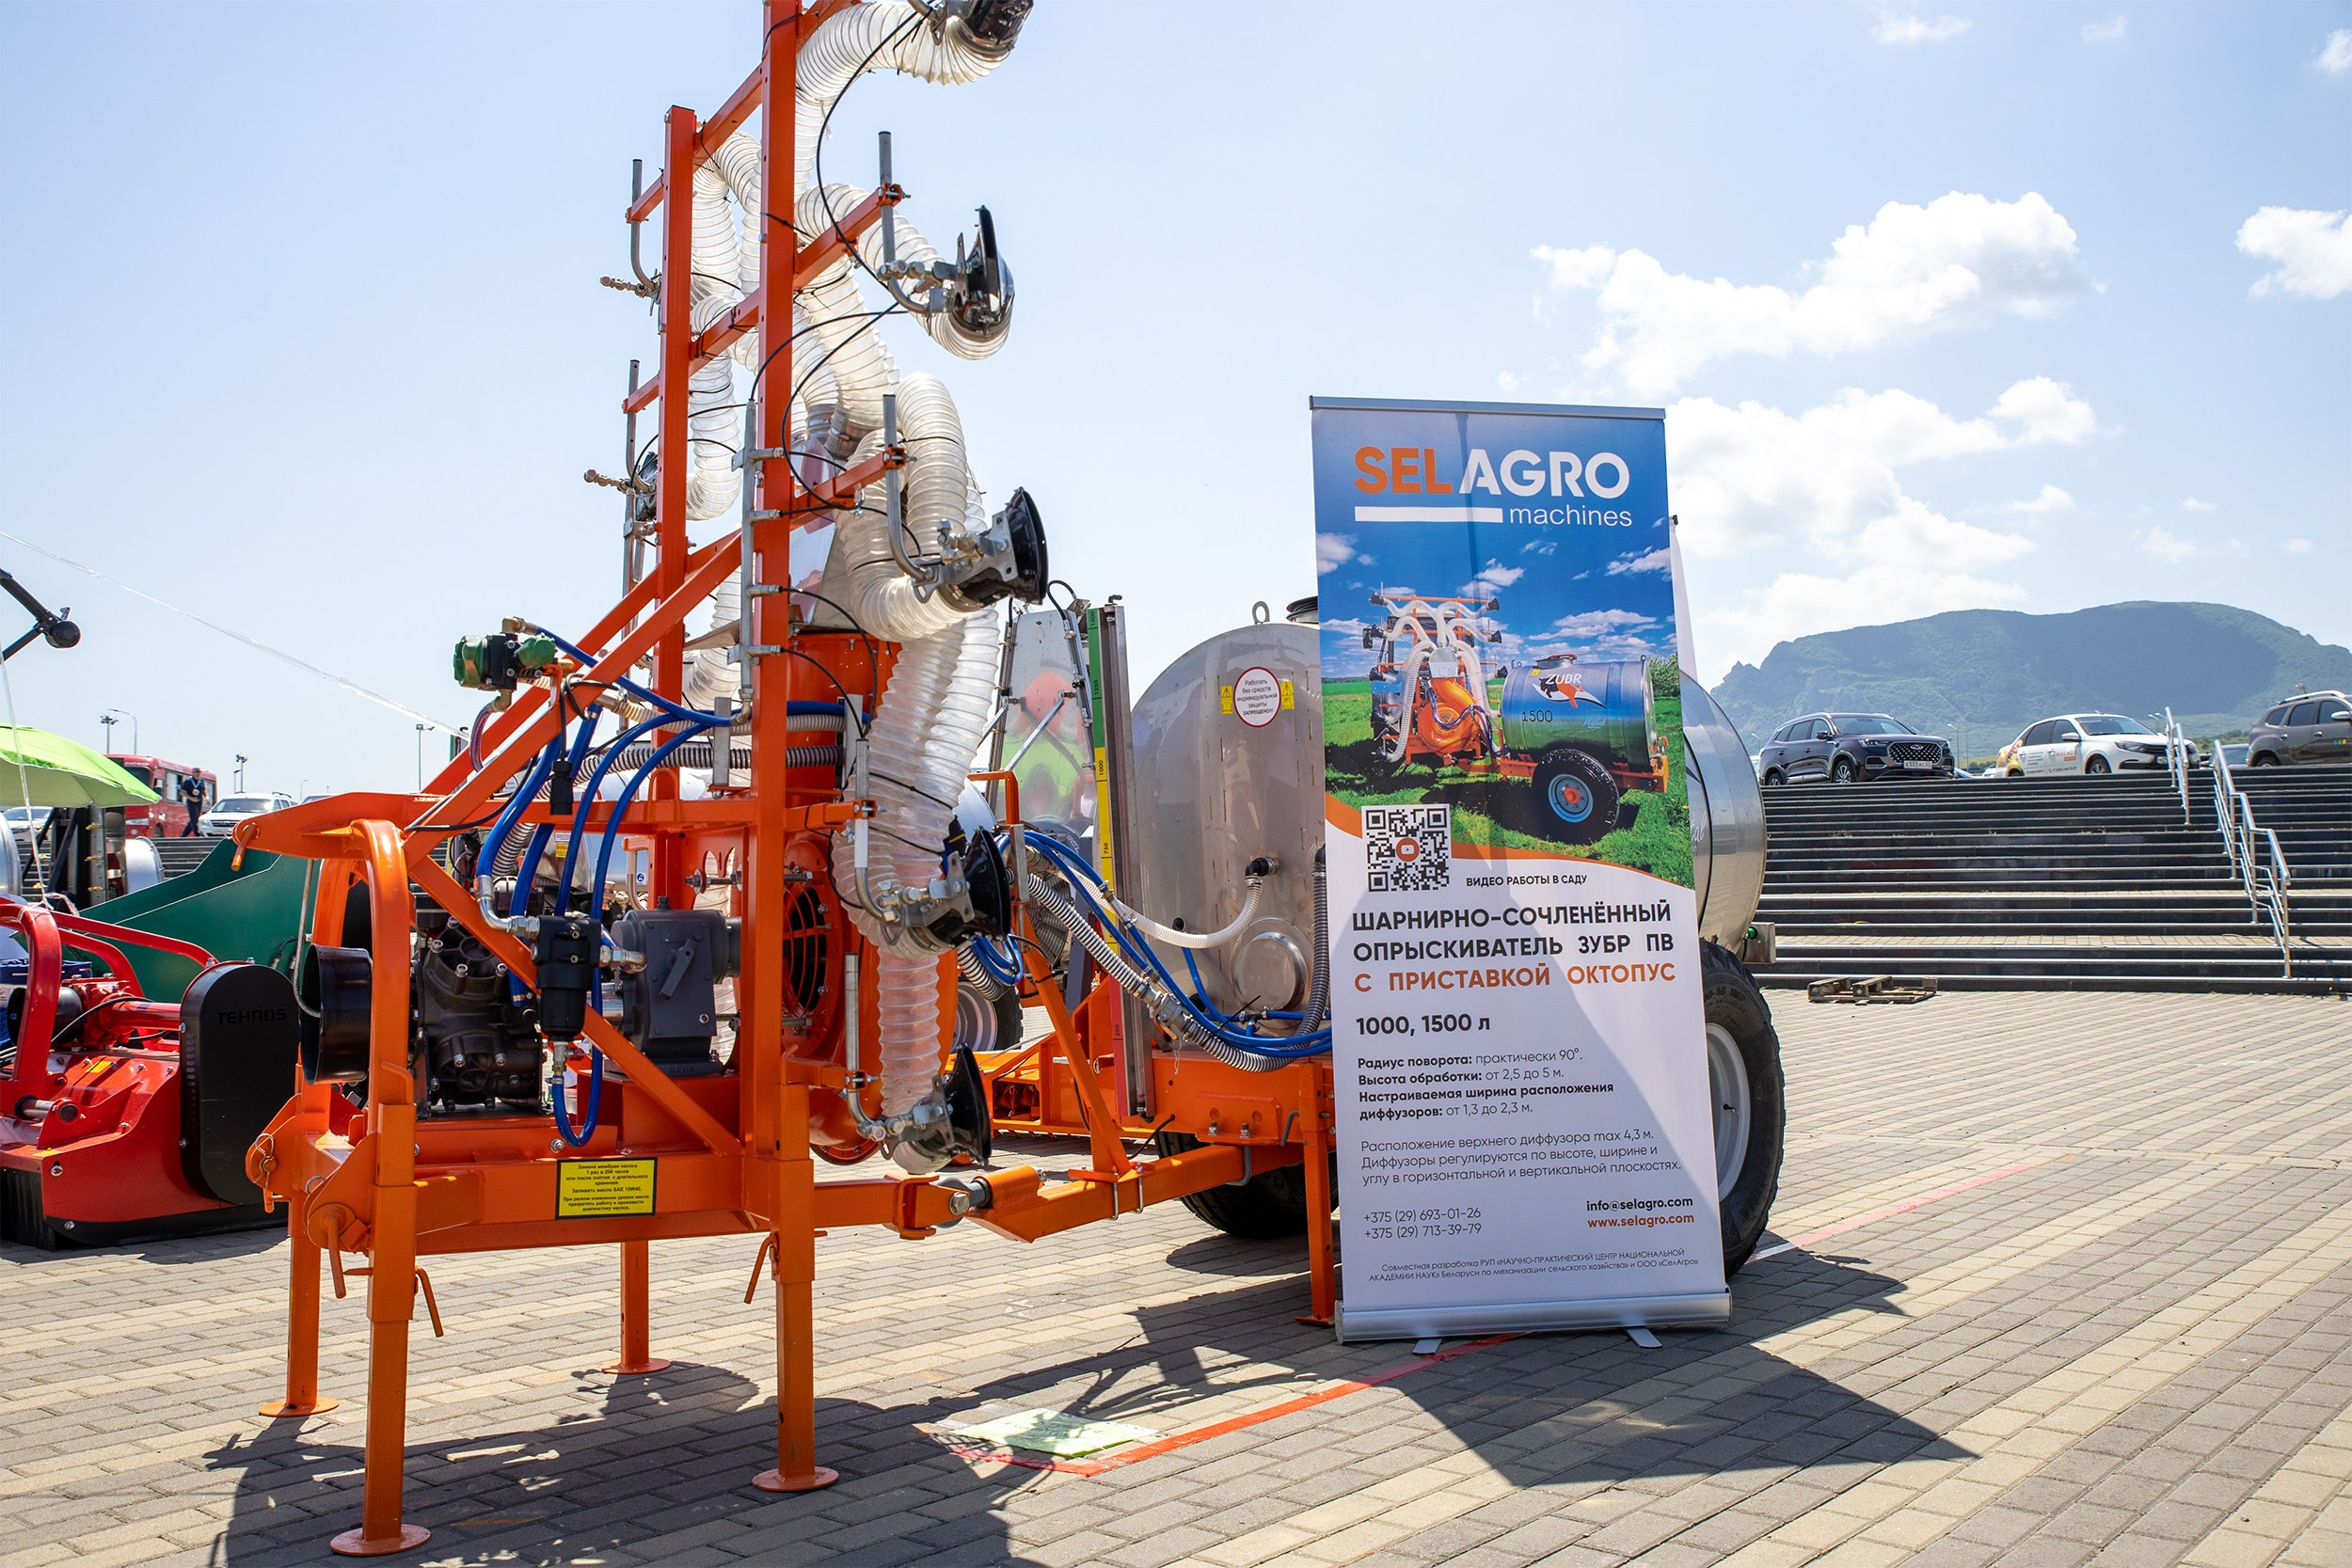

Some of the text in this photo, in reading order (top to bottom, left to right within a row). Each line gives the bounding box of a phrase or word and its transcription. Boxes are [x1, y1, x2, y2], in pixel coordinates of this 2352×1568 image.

[1509, 504, 1632, 527] machines
[1545, 673, 1582, 686] ZUBR
[1521, 709, 1553, 722] 1500
[1466, 875, 1588, 887] ВИДЕО РАБОТЫ В САДУ
[1352, 899, 1672, 931] ШАРНИРНО-СОЧЛЕНЁННЫЙ
[1353, 933, 1674, 962] ОПРЫСКИВАТЕЛЬ ЗУБР ПВ
[1354, 962, 1676, 992] С ПРИСТАВКОЙ ОКТОПУС
[217, 1008, 287, 1024] TEHNOS
[1356, 1014, 1490, 1037] 1000, 1500 л
[1358, 1058, 1404, 1070] Радиус
[1407, 1056, 1472, 1068] поворота:
[1475, 1053, 1556, 1066] практически
[1359, 1067, 1564, 1085] Высота обработки: от 2,5 до 5 м.
[1359, 1084, 1614, 1104] Настраиваемая ширина расположения
[1359, 1102, 1533, 1121] диффузоров: от 1,3 до 2,3 м.
[1361, 1128, 1654, 1152] Расположение верхнего диффузора max 4,3 м.
[1361, 1146, 1658, 1170] Диффузоры регулируются по высоте, ширине и
[1362, 1160, 1682, 1187] углу в горизонтальной и вертикальной плоскостях.
[1586, 1197, 1693, 1212] info@selagro.com
[1364, 1207, 1481, 1223] +375 (29) 693-01-26
[1587, 1214, 1694, 1228] www.selagro.com
[1365, 1223, 1482, 1239] +375 (29) 713-39-79
[1381, 1248, 1685, 1272] Совместная разработка РУП «НАУЧНО-ПРАКТИЧЕСКИЙ ЦЕНТР НАЦИОНАЛЬНОЙ
[1369, 1272, 1414, 1282] АКАДЕМИИ
[1441, 1270, 1480, 1279] Беларуси
[1494, 1267, 1547, 1275] механизации
